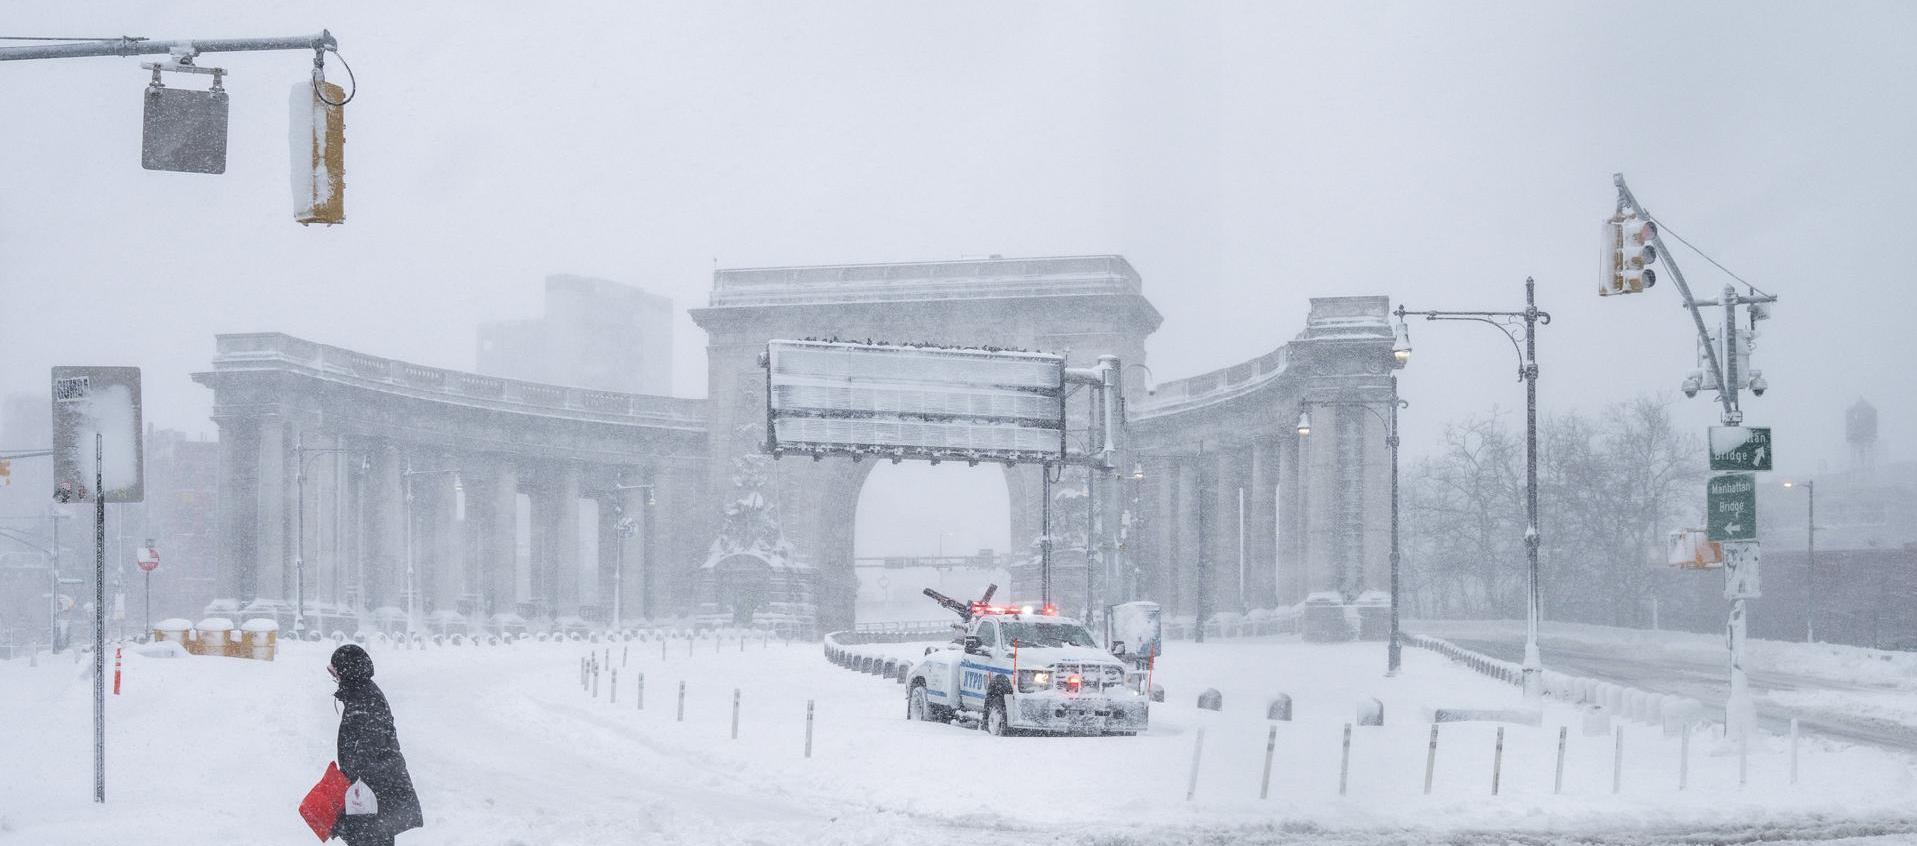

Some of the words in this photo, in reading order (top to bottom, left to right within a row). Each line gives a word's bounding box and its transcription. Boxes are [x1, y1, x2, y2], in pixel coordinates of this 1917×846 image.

[1711, 482, 1751, 494] Manhattan
[1719, 500, 1745, 514] Bridge
[963, 670, 984, 690] NYPD
